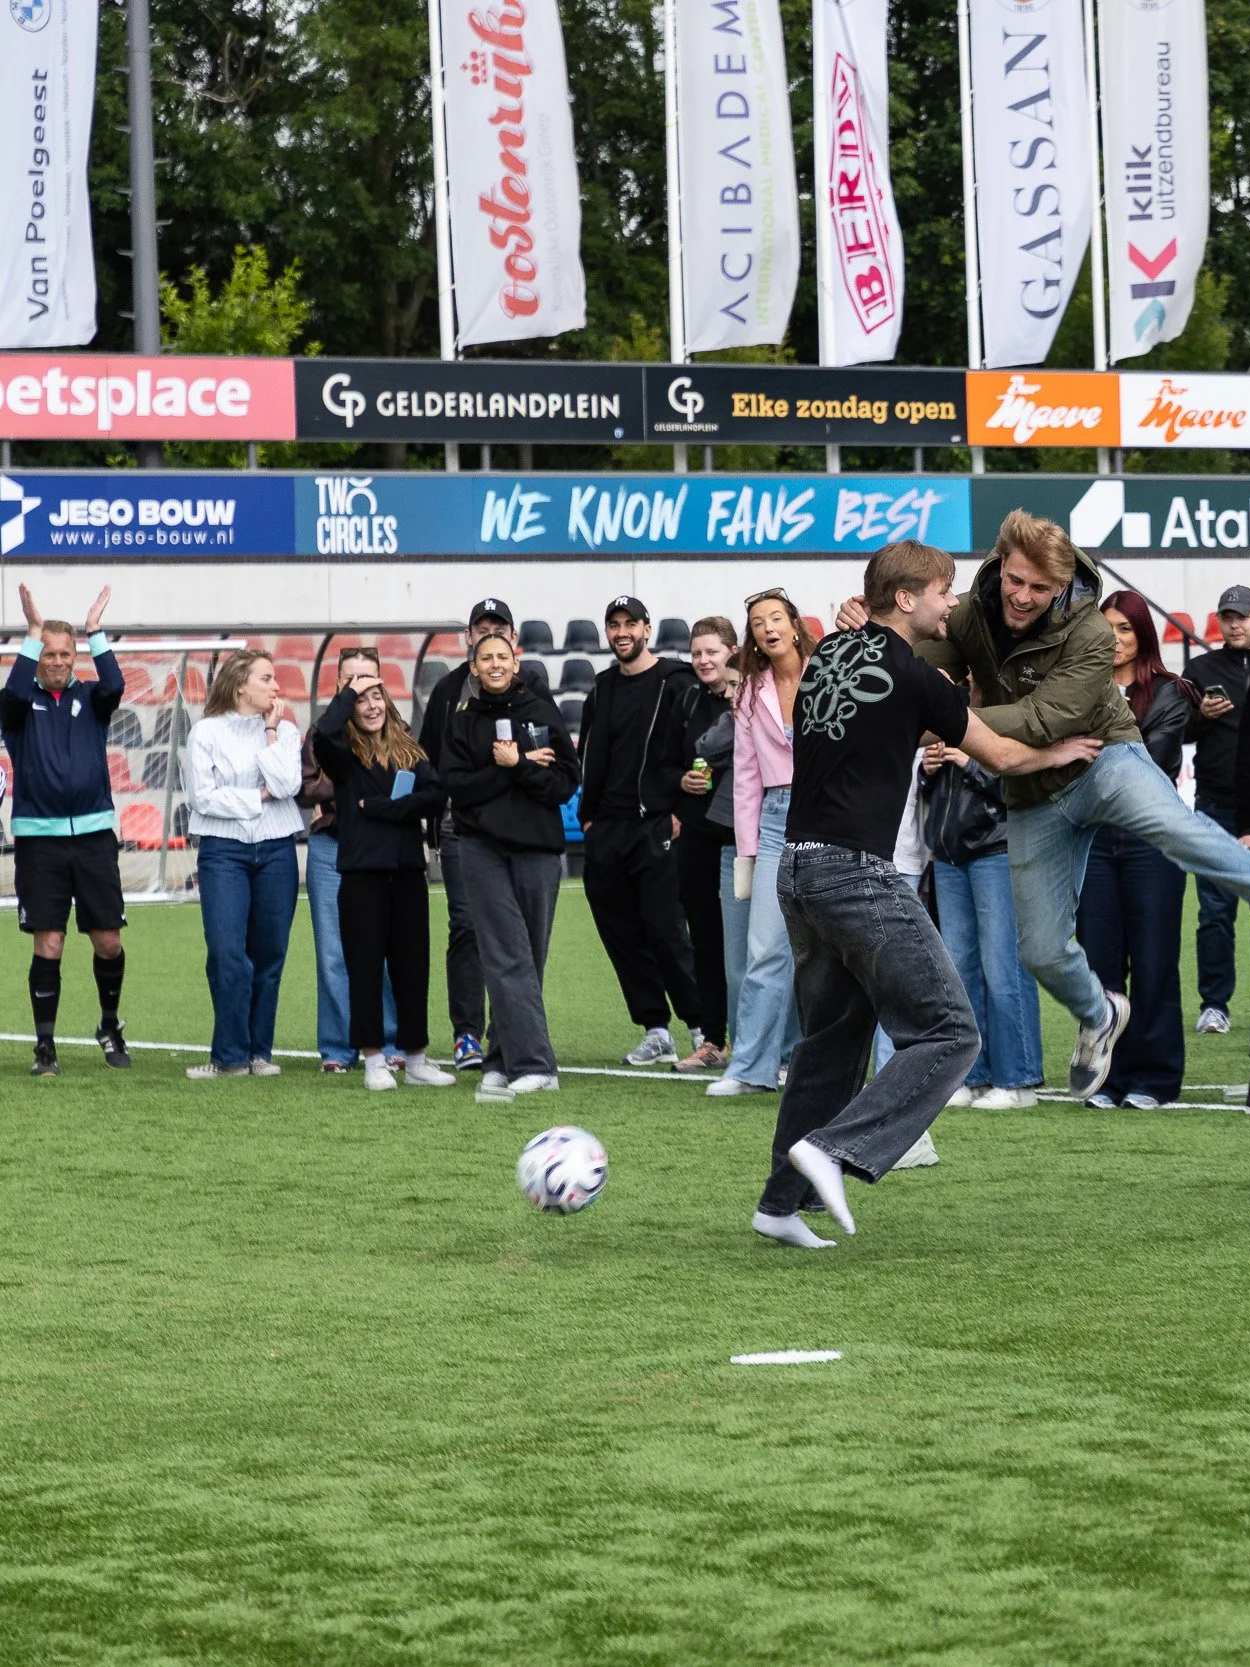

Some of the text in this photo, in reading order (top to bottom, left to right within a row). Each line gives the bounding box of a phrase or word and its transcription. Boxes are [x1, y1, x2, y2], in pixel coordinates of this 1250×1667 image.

[756, 83, 774, 168] MEDICAL
[1154, 41, 1177, 221] uitzendbureau
[25, 68, 51, 323] Van Poelgeest
[1002, 26, 1063, 320] GASSAN
[1124, 144, 1154, 222] klik
[756, 175, 775, 326] INTERNATIONAL
[0, 367, 251, 431] etsplace
[376, 390, 620, 419] GELDERLANDPLEIN
[731, 392, 957, 425] Elke zondag open
[984, 393, 1103, 445] Maeve
[1137, 396, 1248, 444] Maeve
[49, 499, 237, 526] JESO BOUW
[50, 527, 235, 549] www.jeso-bouw.nl
[316, 515, 399, 555] CIRCLES
[480, 482, 950, 550] WE KNOW FANS BEST
